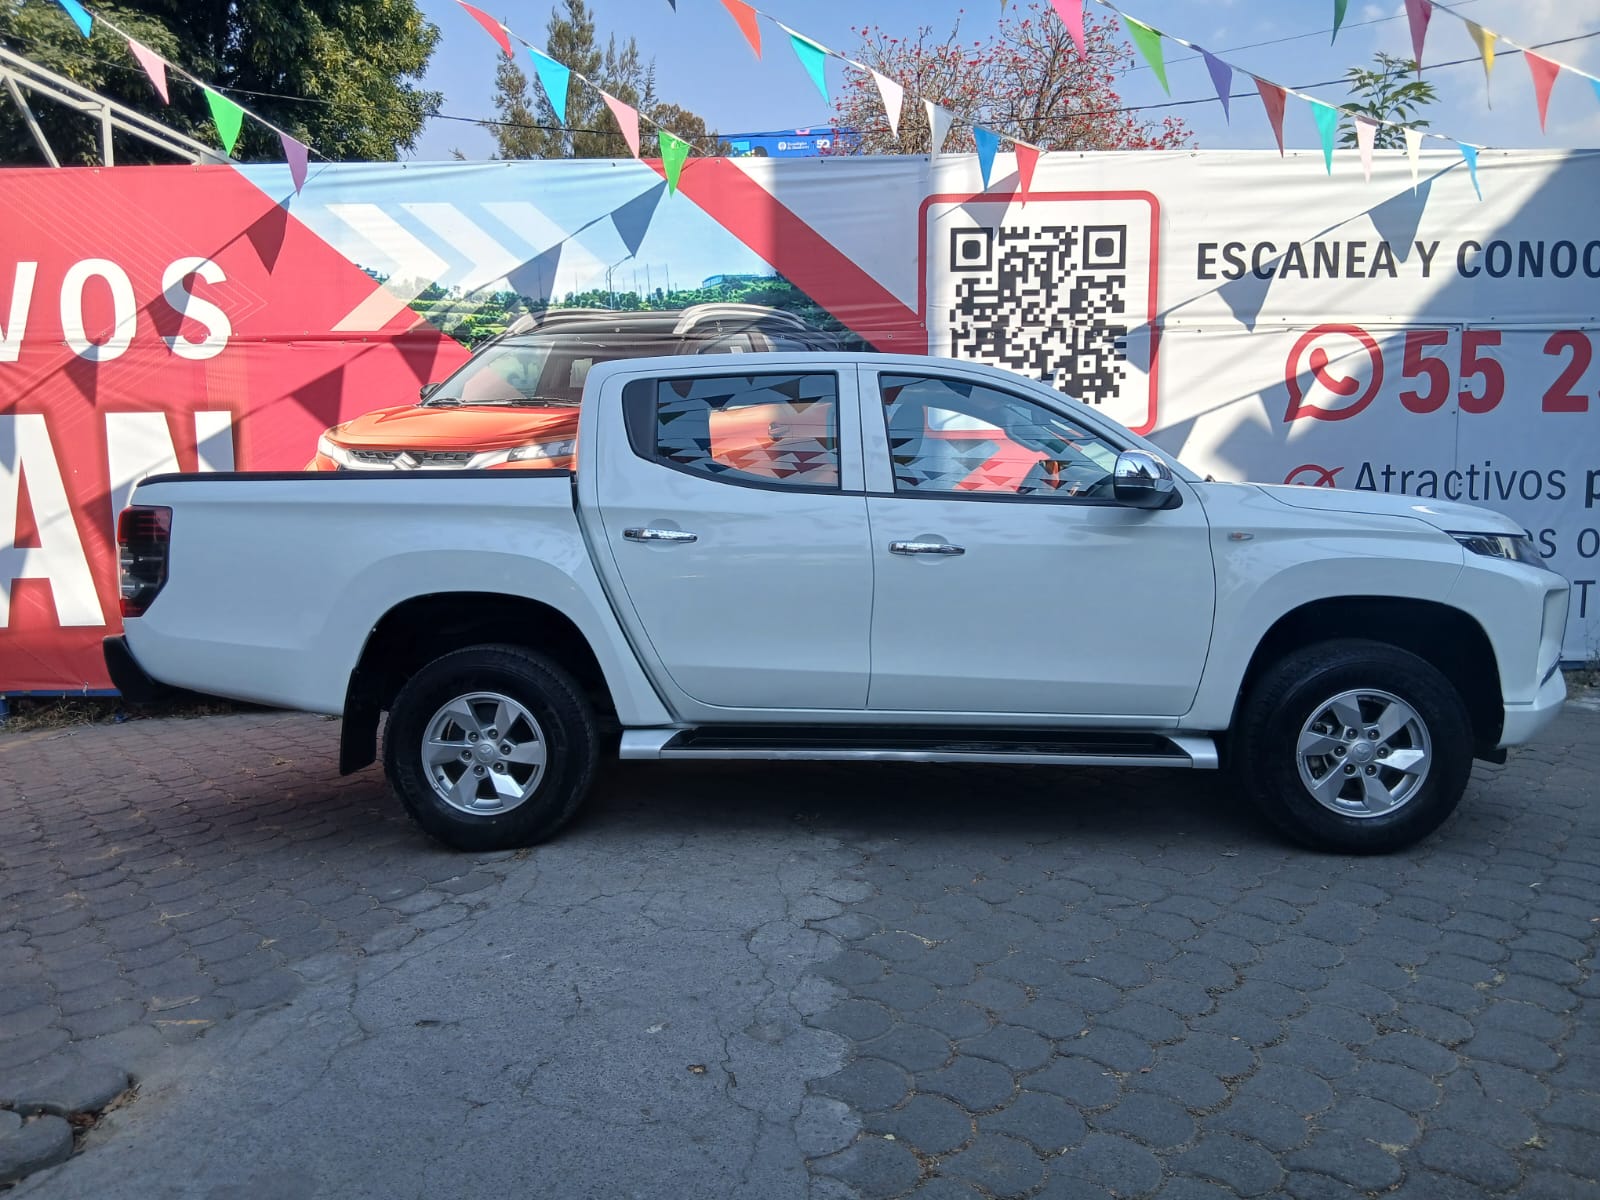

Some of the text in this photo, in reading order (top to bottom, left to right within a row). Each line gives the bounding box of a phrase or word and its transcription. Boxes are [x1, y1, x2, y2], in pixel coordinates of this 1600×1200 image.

[1197, 240, 1398, 280] ESCANEA
[1414, 240, 1440, 279] Y
[1398, 330, 1505, 415] 55
[1354, 460, 1567, 502] Atractivos
[1573, 579, 1597, 619] T
